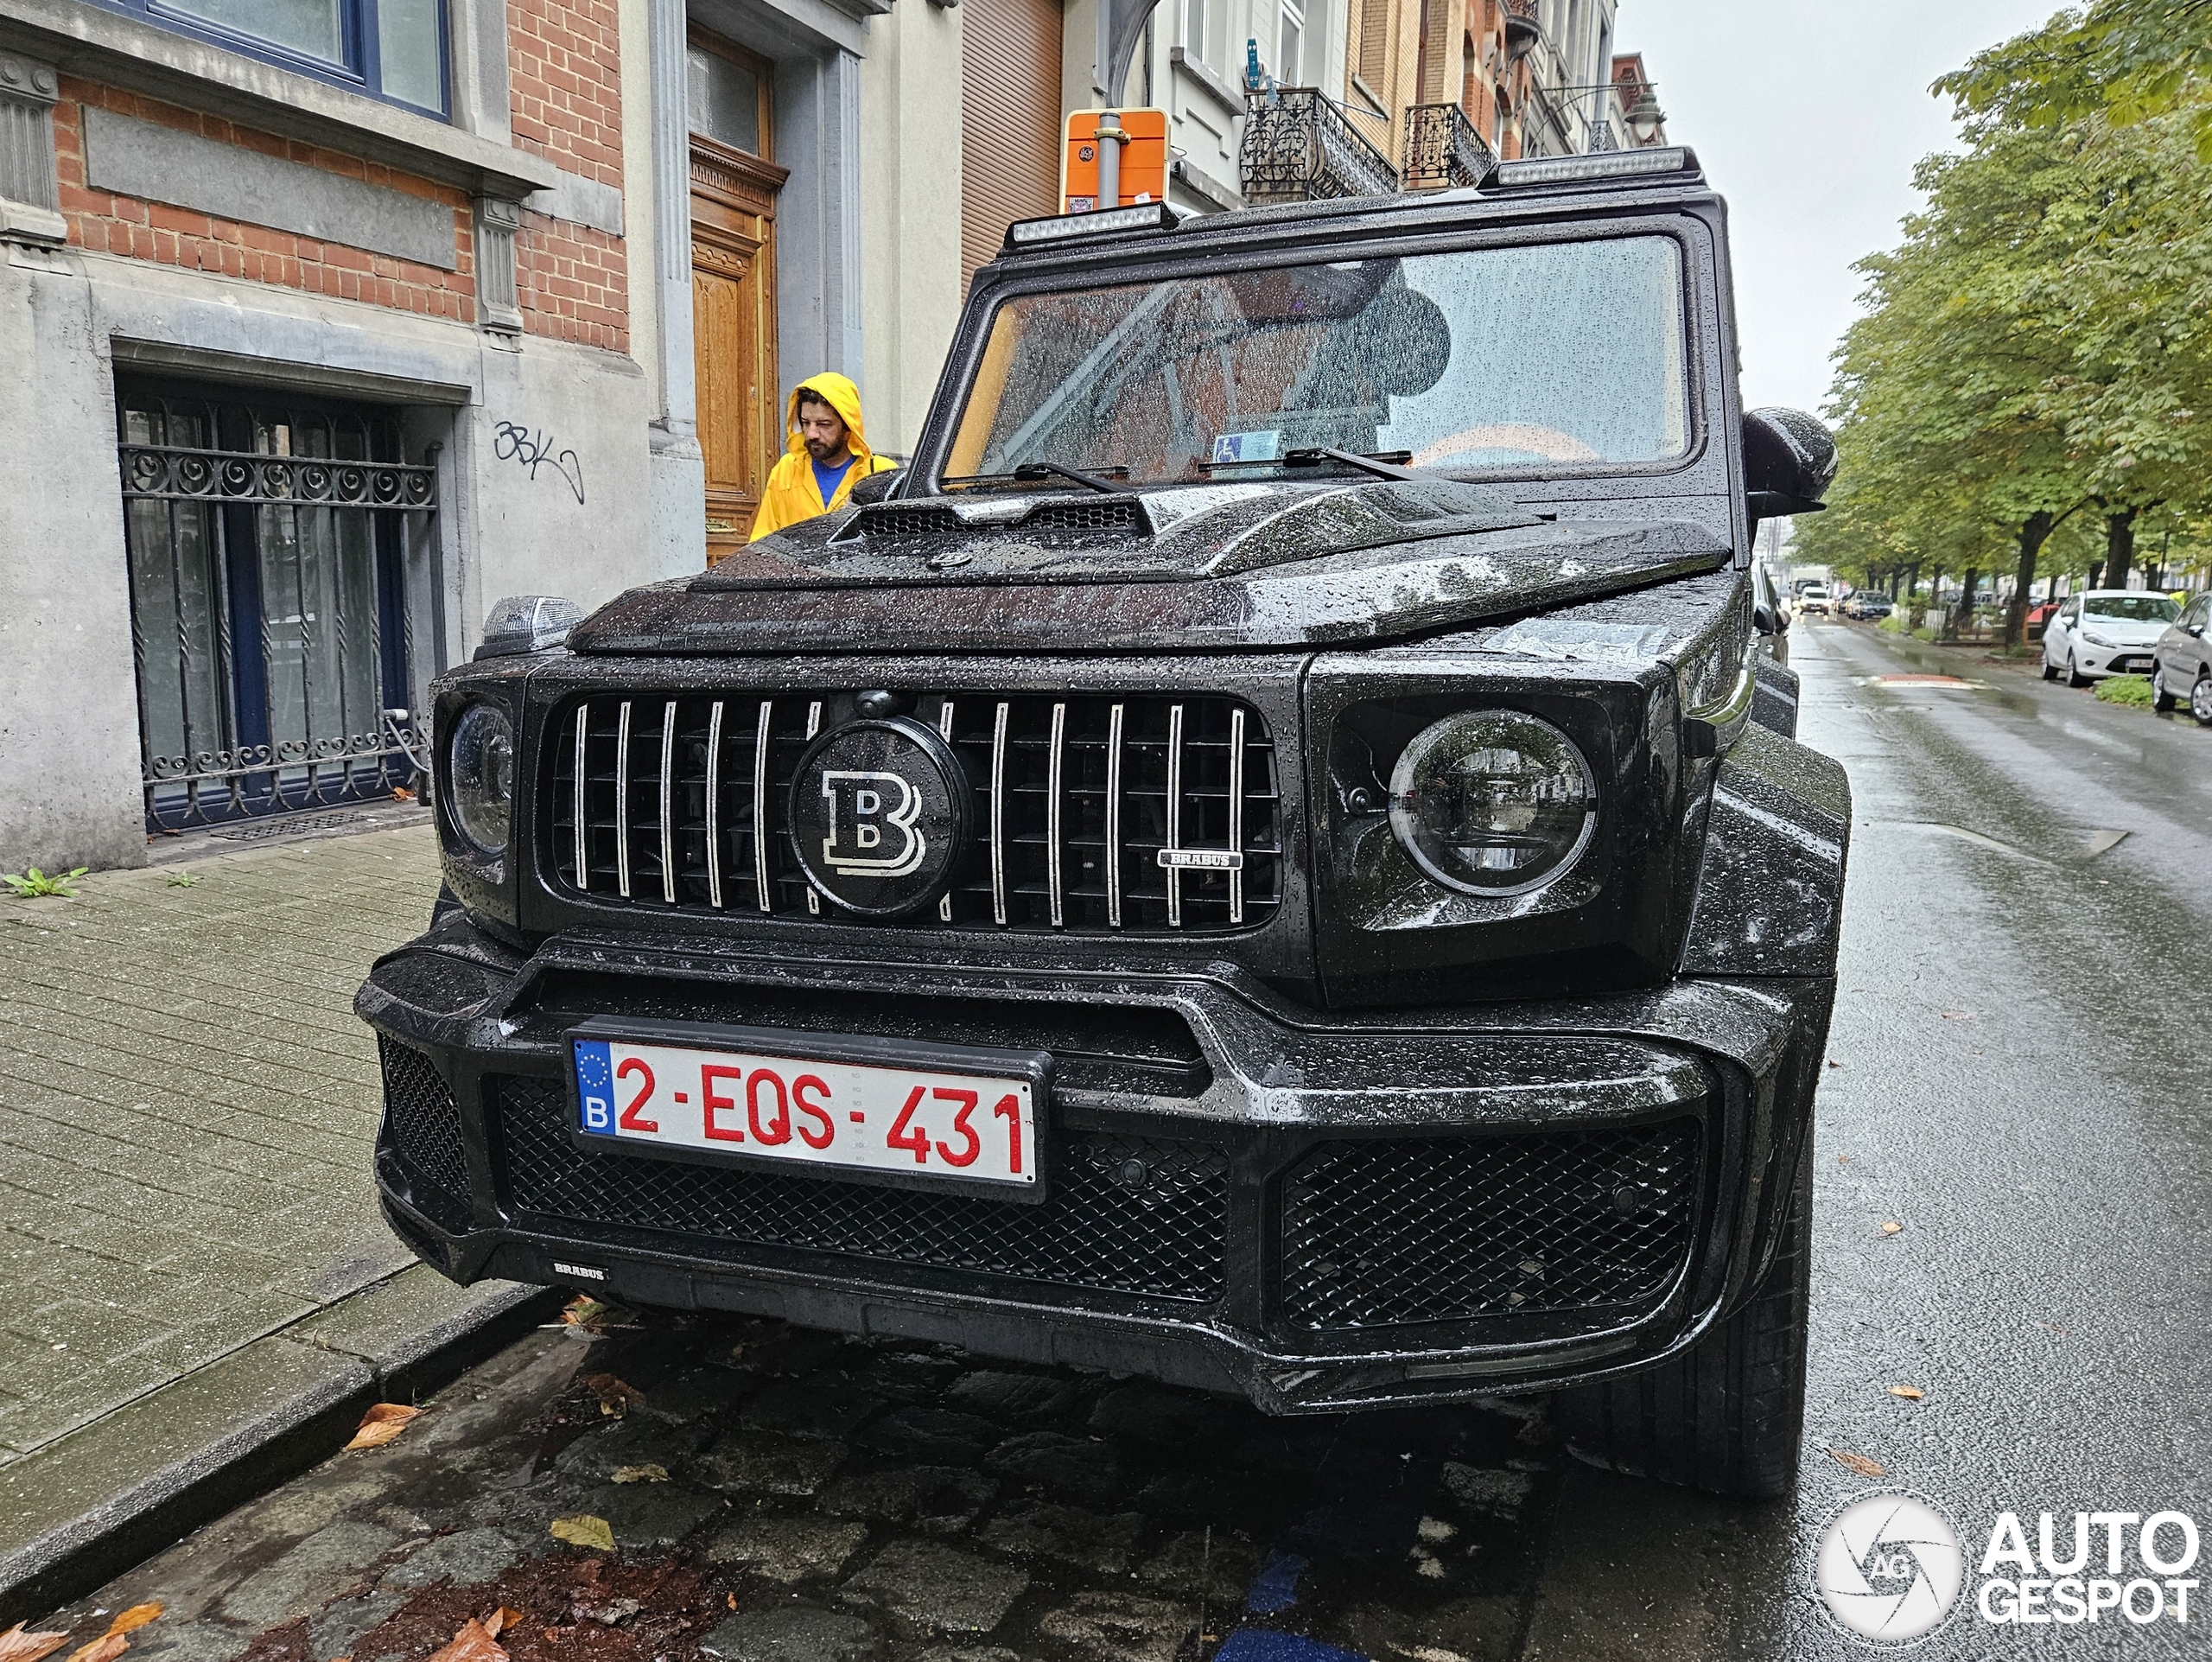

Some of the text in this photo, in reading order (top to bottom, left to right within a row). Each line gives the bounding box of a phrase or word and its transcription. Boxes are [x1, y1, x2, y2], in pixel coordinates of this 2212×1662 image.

[823, 771, 926, 876] B
[1170, 853, 1230, 867] BRABUS
[585, 1096, 608, 1128] B
[554, 1263, 604, 1281] BRABUS
